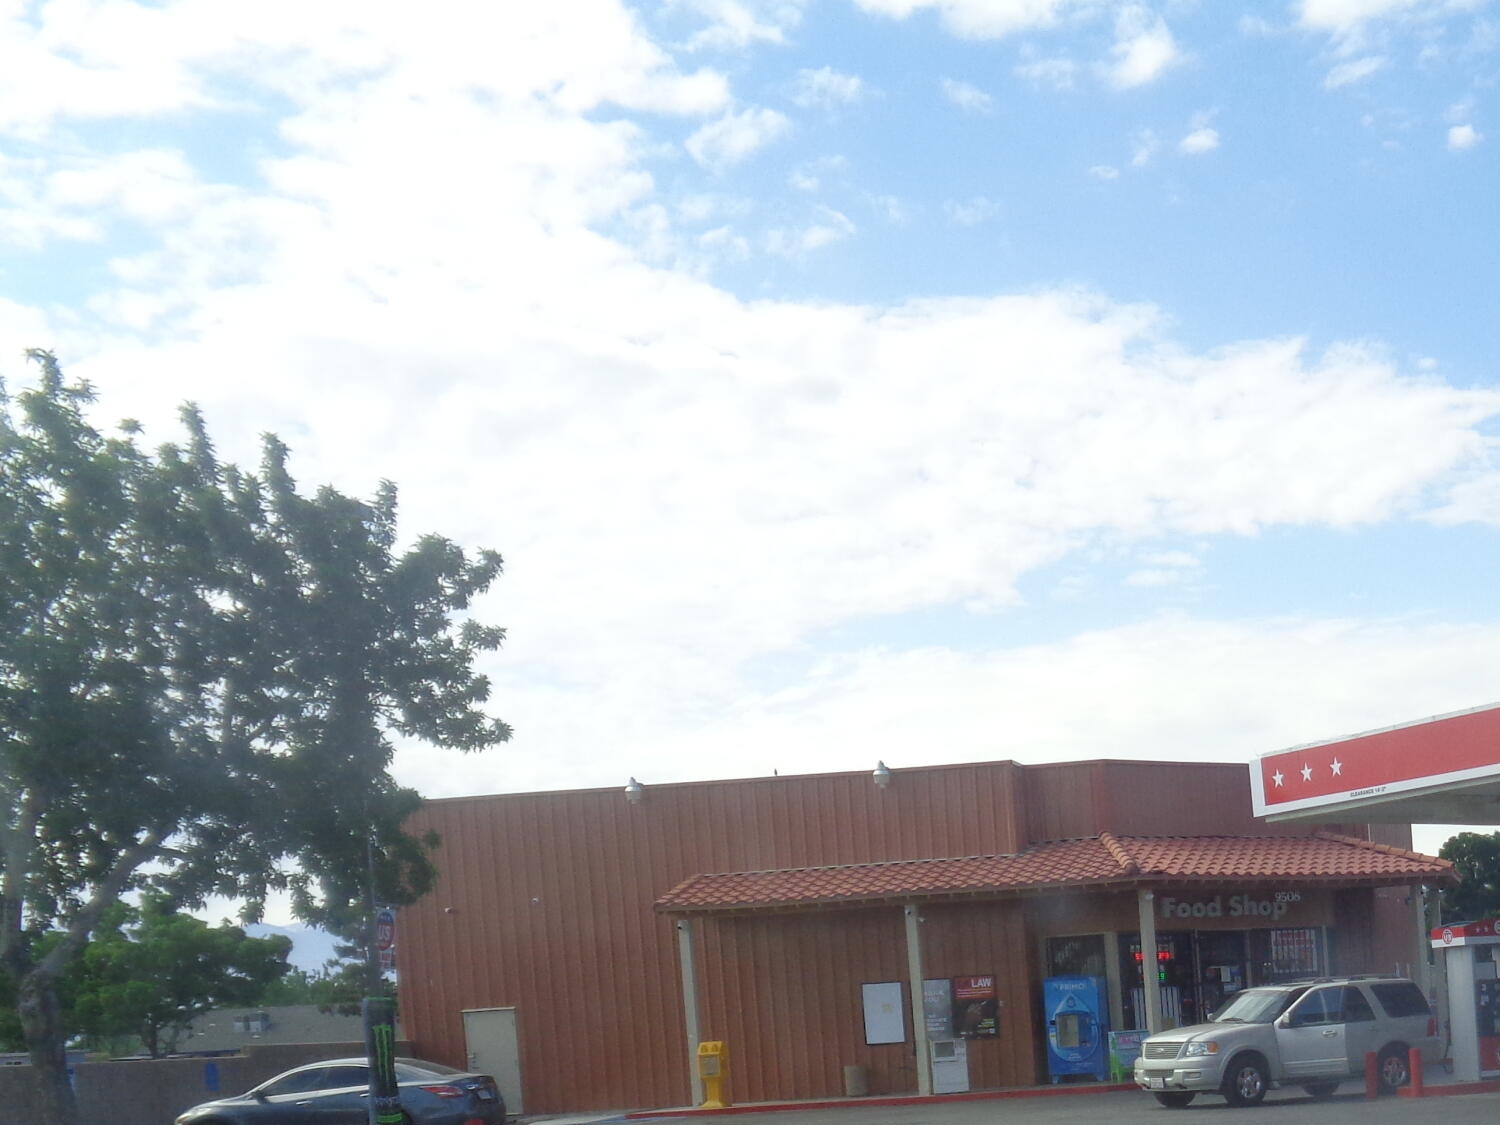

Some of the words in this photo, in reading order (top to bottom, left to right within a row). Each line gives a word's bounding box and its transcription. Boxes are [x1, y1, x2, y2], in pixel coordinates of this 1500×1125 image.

[1161, 897, 1222, 918] Food
[1229, 895, 1288, 920] Shop
[971, 977, 992, 988] LAW
